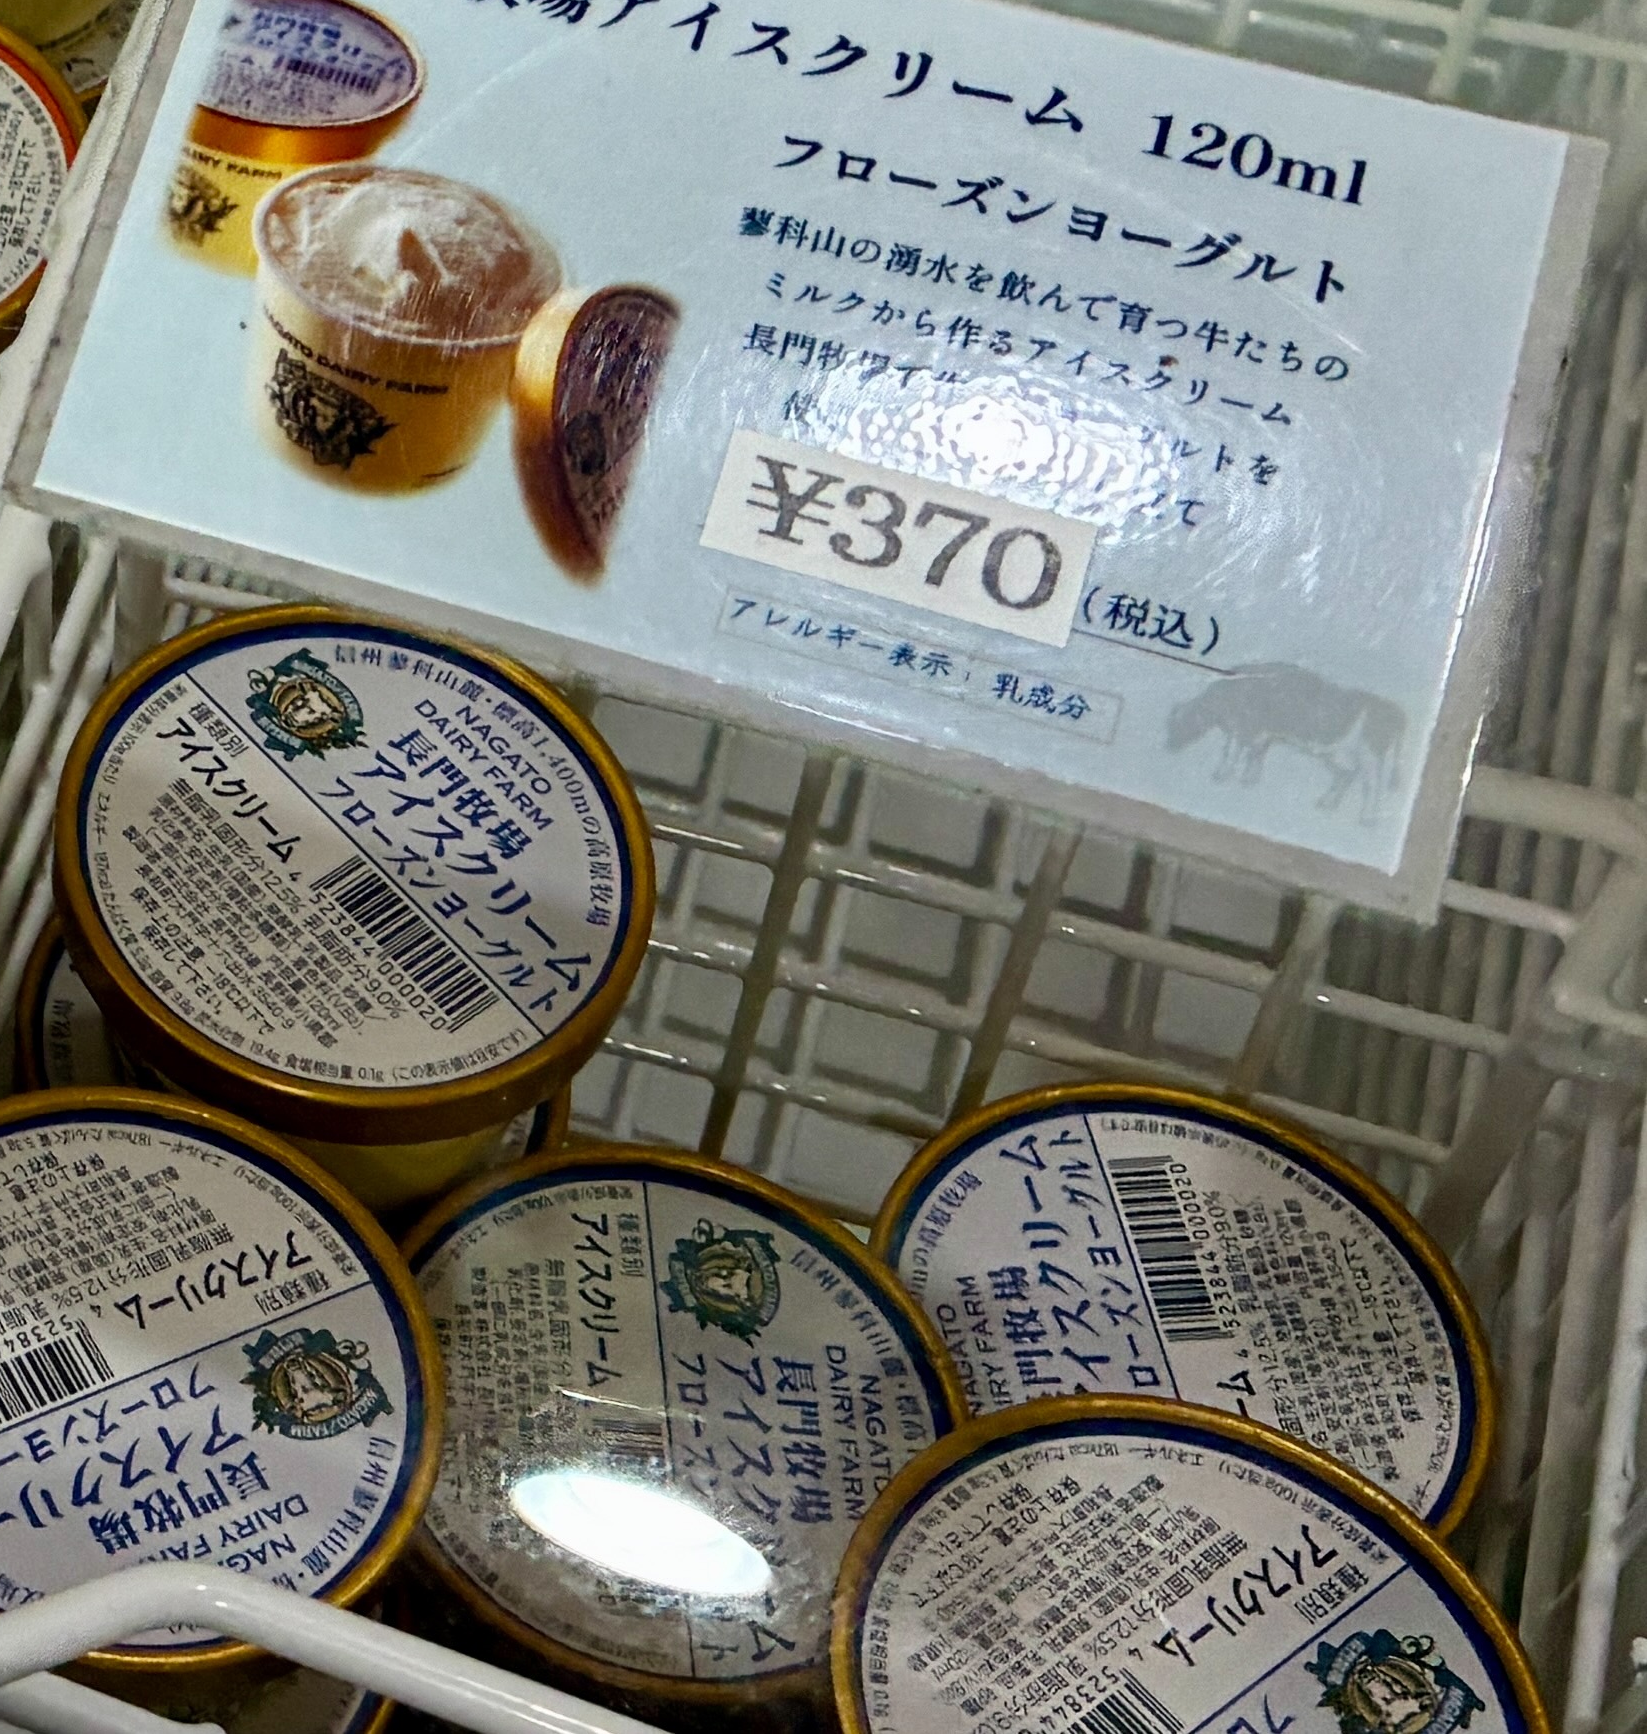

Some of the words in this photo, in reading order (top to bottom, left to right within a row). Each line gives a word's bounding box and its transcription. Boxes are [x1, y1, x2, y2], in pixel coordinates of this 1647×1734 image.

[772, 134, 1347, 305] フローズンヨーグルト
[1139, 111, 1369, 207] 120ml
[739, 207, 1351, 385] 蓼科山の湧水を飲んで育つ牛たちの
[763, 271, 1293, 427] ミルクから作るアイスクリーム
[746, 455, 1063, 611] ¥370
[1082, 586, 1226, 656] （税込）
[729, 598, 954, 677] アレルギー表示
[992, 673, 1092, 719] 乳成分
[155, 716, 305, 859] アイスクリーム
[187, 699, 247, 757] 種類別
[389, 724, 530, 859] 長門牧場
[413, 697, 487, 768] DAIRY
[482, 765, 552, 831] FARM
[454, 704, 554, 798] NAGATO
[126, 885, 206, 962] 保存上の注意
[314, 778, 567, 1017] フローズンヨーグルト
[347, 750, 600, 990] アイスクリーム
[308, 891, 378, 958] 523844
[375, 961, 447, 1028] 000020
[115, 1232, 311, 1330] アイスクリーム
[254, 1270, 328, 1313] 種類別
[572, 1212, 622, 1384] アイスクリーム
[776, 1356, 827, 1522] 長門牧場
[827, 1345, 854, 1430] DAIRY
[88, 1454, 269, 1550] 長門牧場
[214, 1494, 306, 1544] DAIRY
[839, 1438, 864, 1519] FARM
[1147, 1523, 1340, 1671] アイスクリーム
